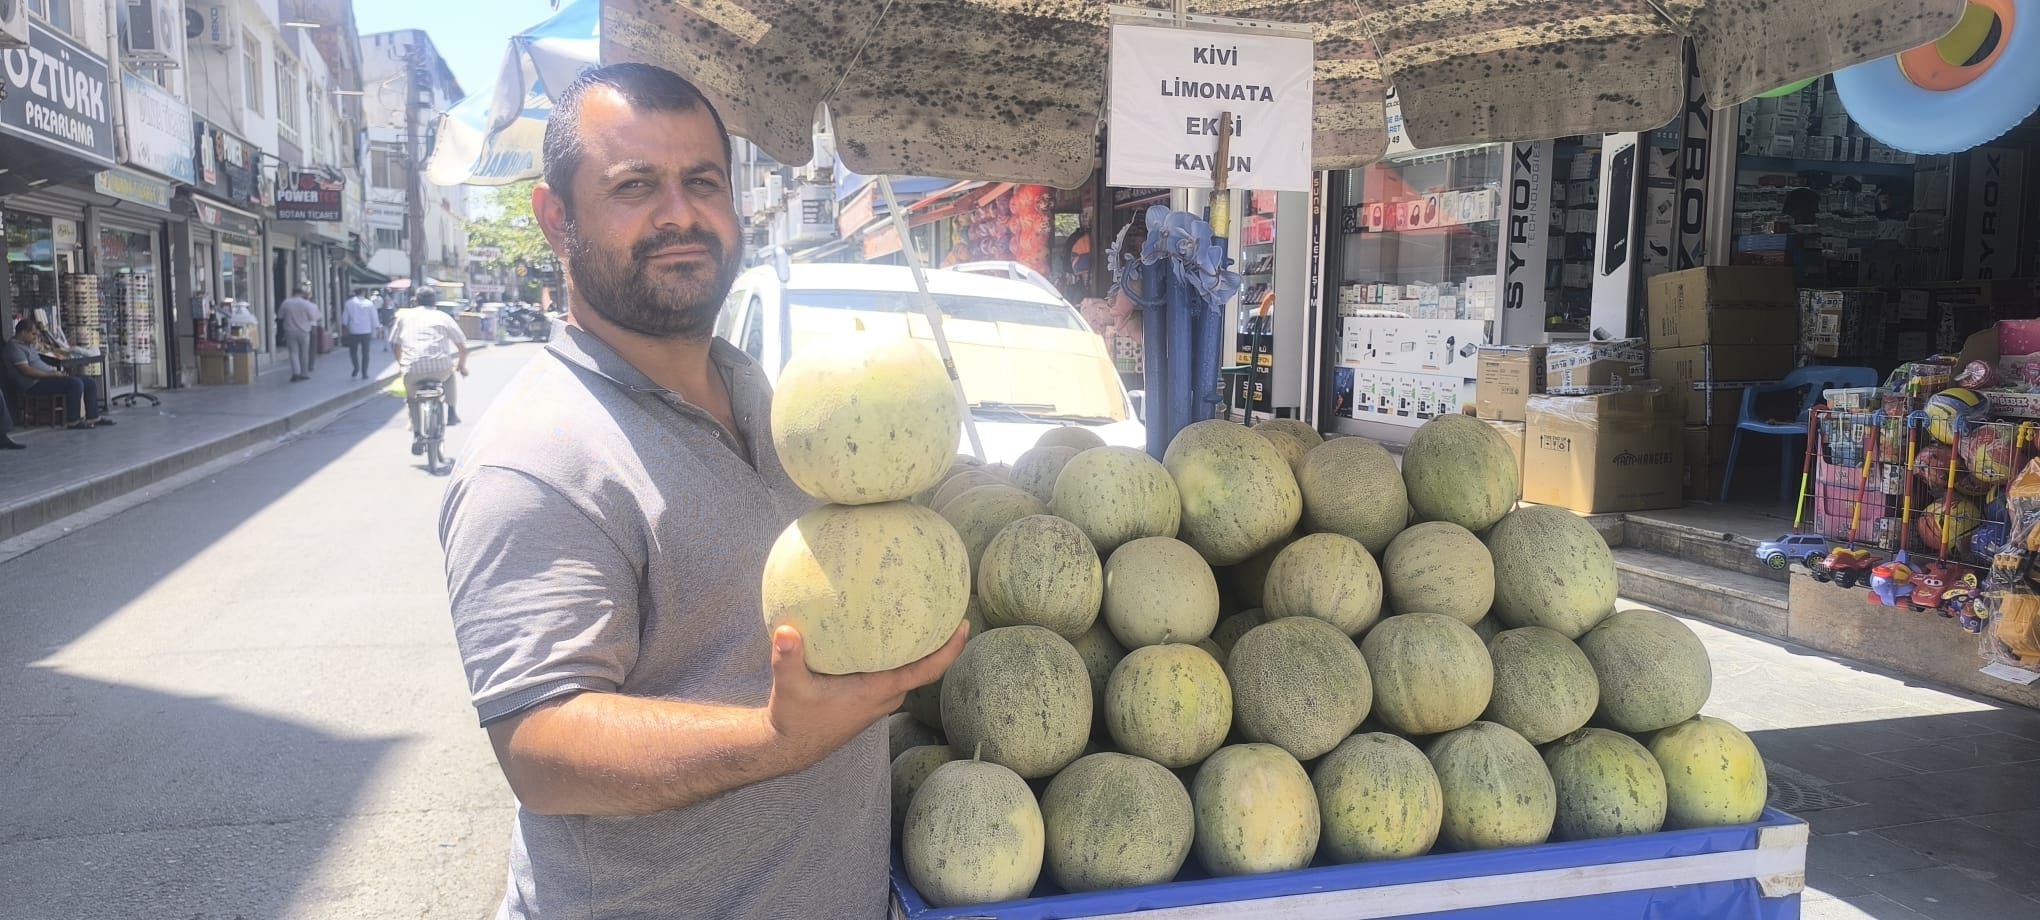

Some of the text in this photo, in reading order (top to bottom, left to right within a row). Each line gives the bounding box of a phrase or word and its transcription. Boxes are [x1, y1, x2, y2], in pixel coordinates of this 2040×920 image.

[1193, 44, 1238, 66] KİVİ
[1160, 76, 1274, 102] LİMONATA
[25, 101, 94, 148] PAZARLAMA
[1528, 141, 1541, 249] TECHNOLOGIES
[1506, 144, 1533, 309] SYROX
